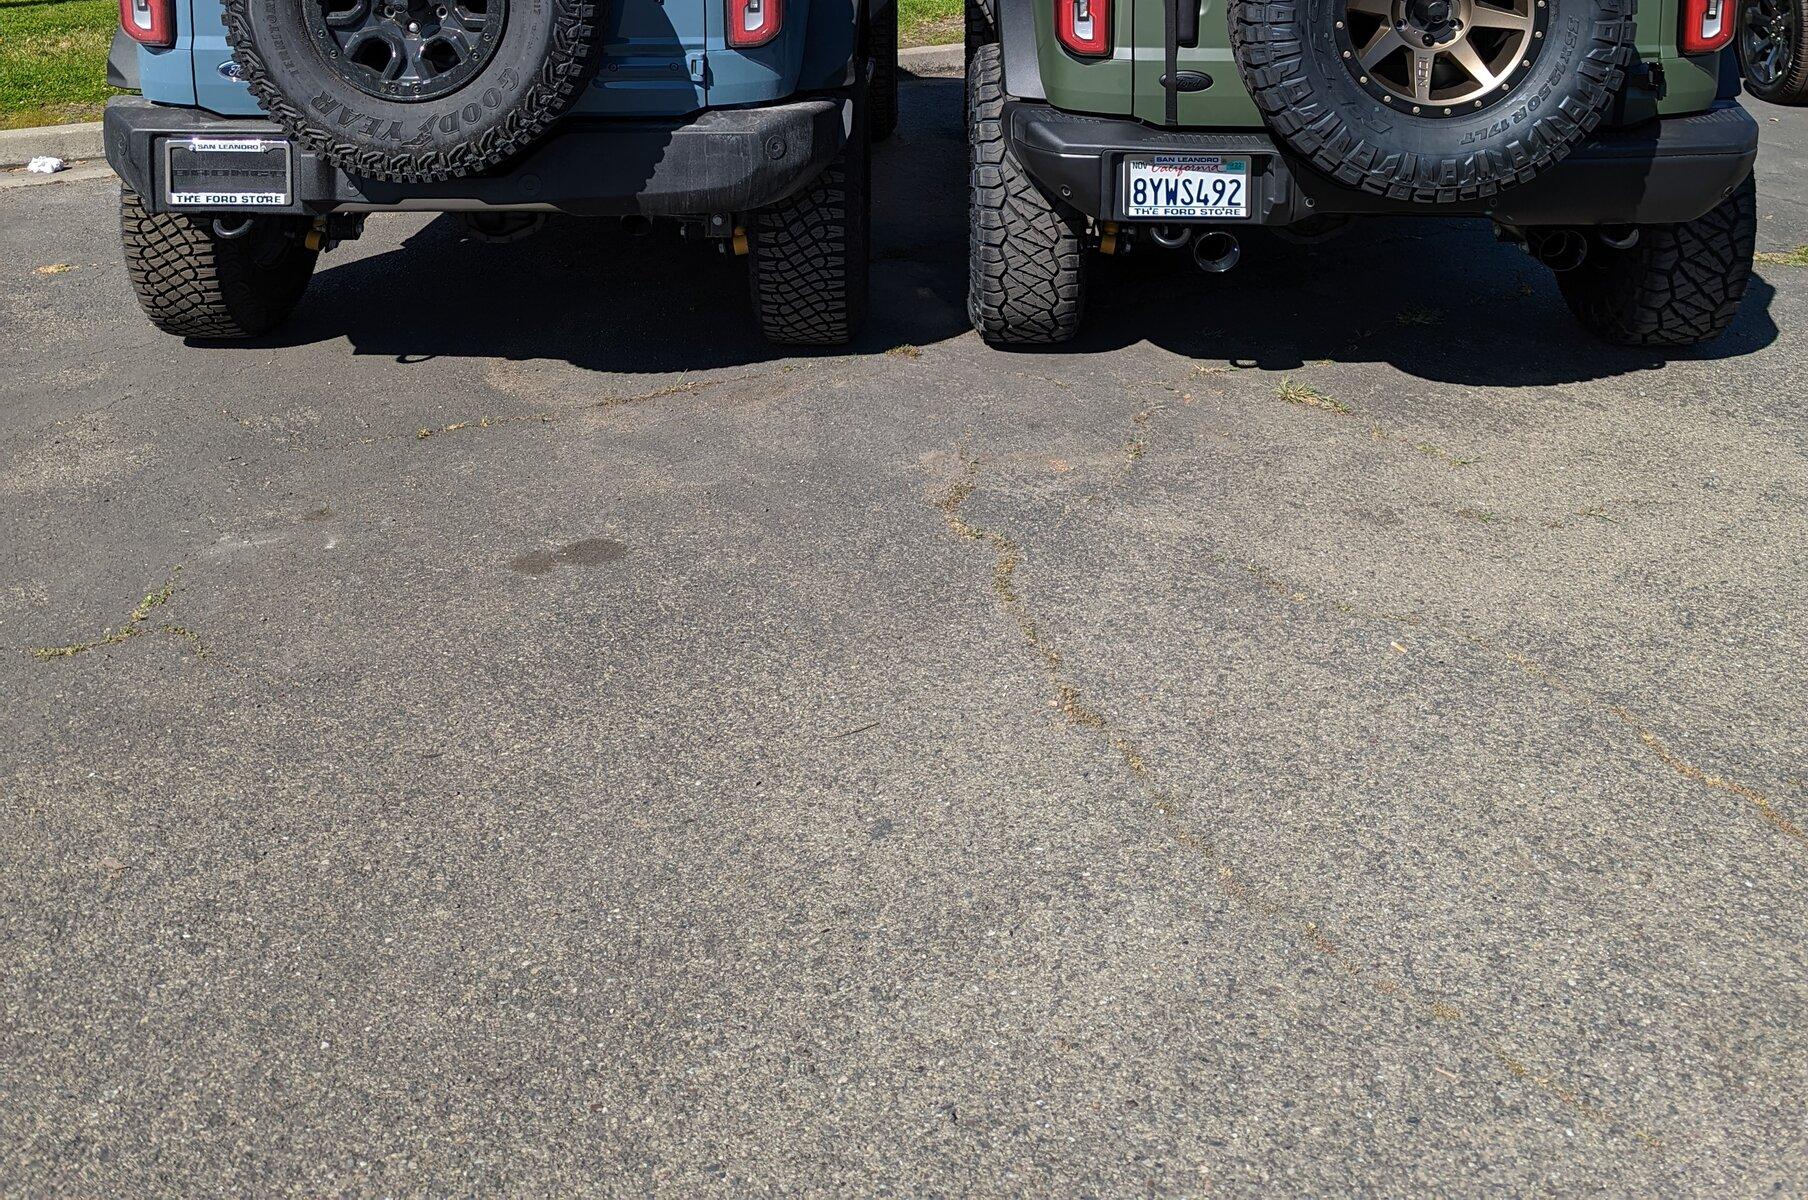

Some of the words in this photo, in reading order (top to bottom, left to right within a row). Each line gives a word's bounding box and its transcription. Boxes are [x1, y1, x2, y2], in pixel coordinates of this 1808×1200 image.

[309, 66, 520, 143] GOODYEAR
[1132, 162, 1148, 170] NOV
[1151, 164, 1224, 177] California
[176, 195, 201, 203] THE
[206, 195, 237, 203] FORD
[241, 195, 282, 203] STORE
[1133, 178, 1242, 206] 8YWS492
[1200, 208, 1241, 216] STORE
